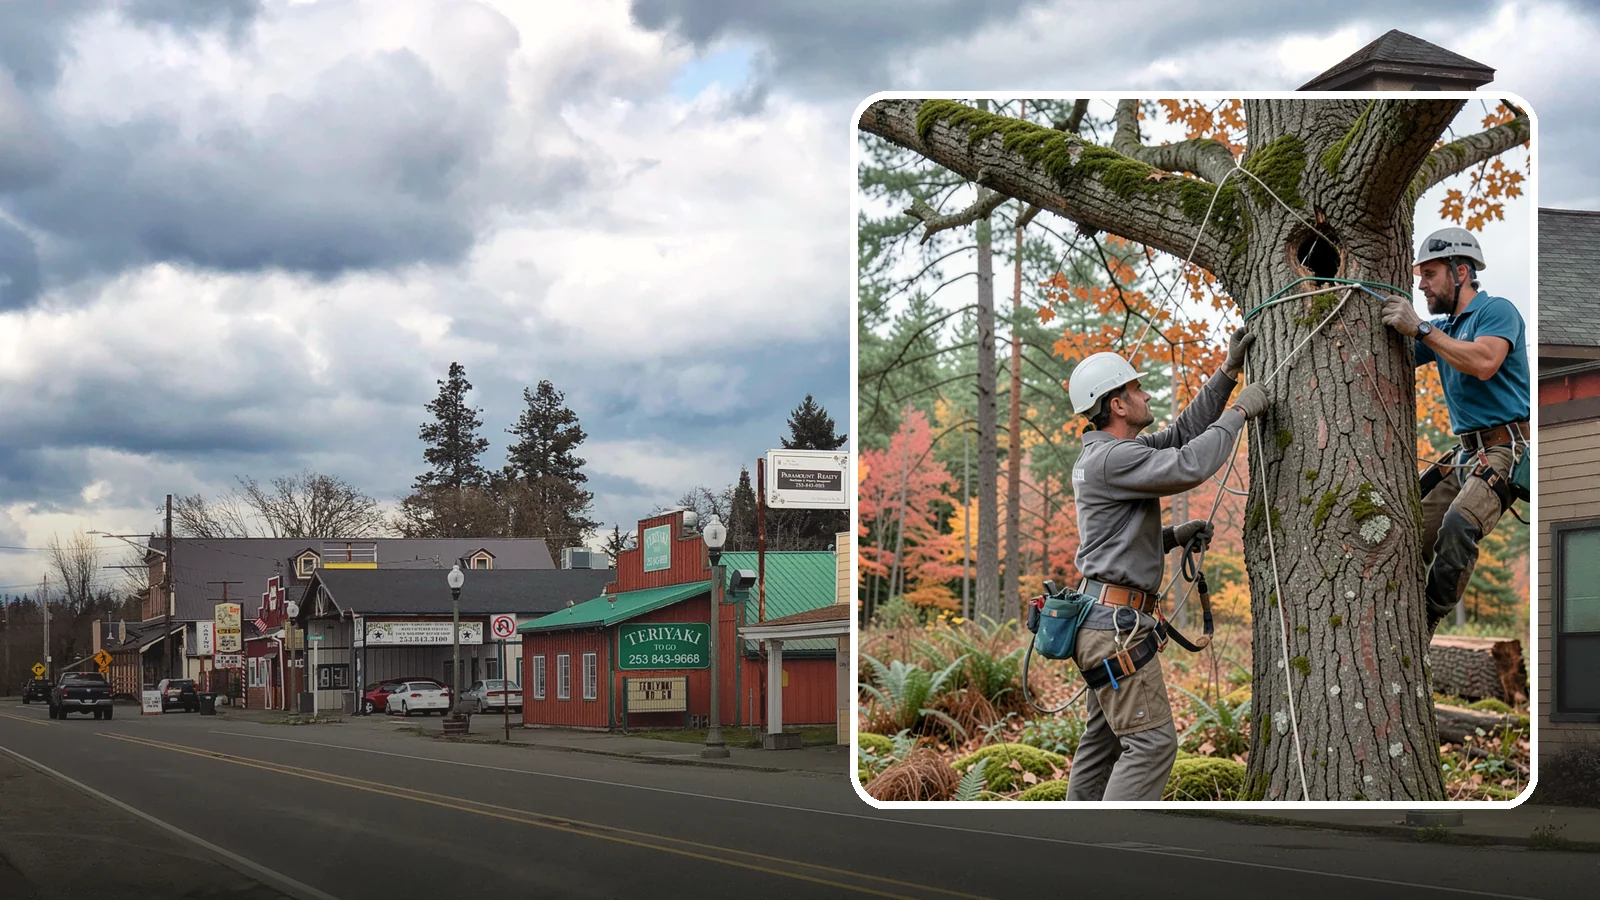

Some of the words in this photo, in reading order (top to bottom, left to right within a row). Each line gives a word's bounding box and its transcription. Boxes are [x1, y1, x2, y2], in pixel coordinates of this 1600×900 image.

[781, 471, 814, 479] PARAMOUNT
[625, 627, 702, 646] TERIYAKI
[629, 655, 648, 664] 253
[651, 654, 700, 664] 843-9668
[639, 681, 673, 690] TERIYAKI
